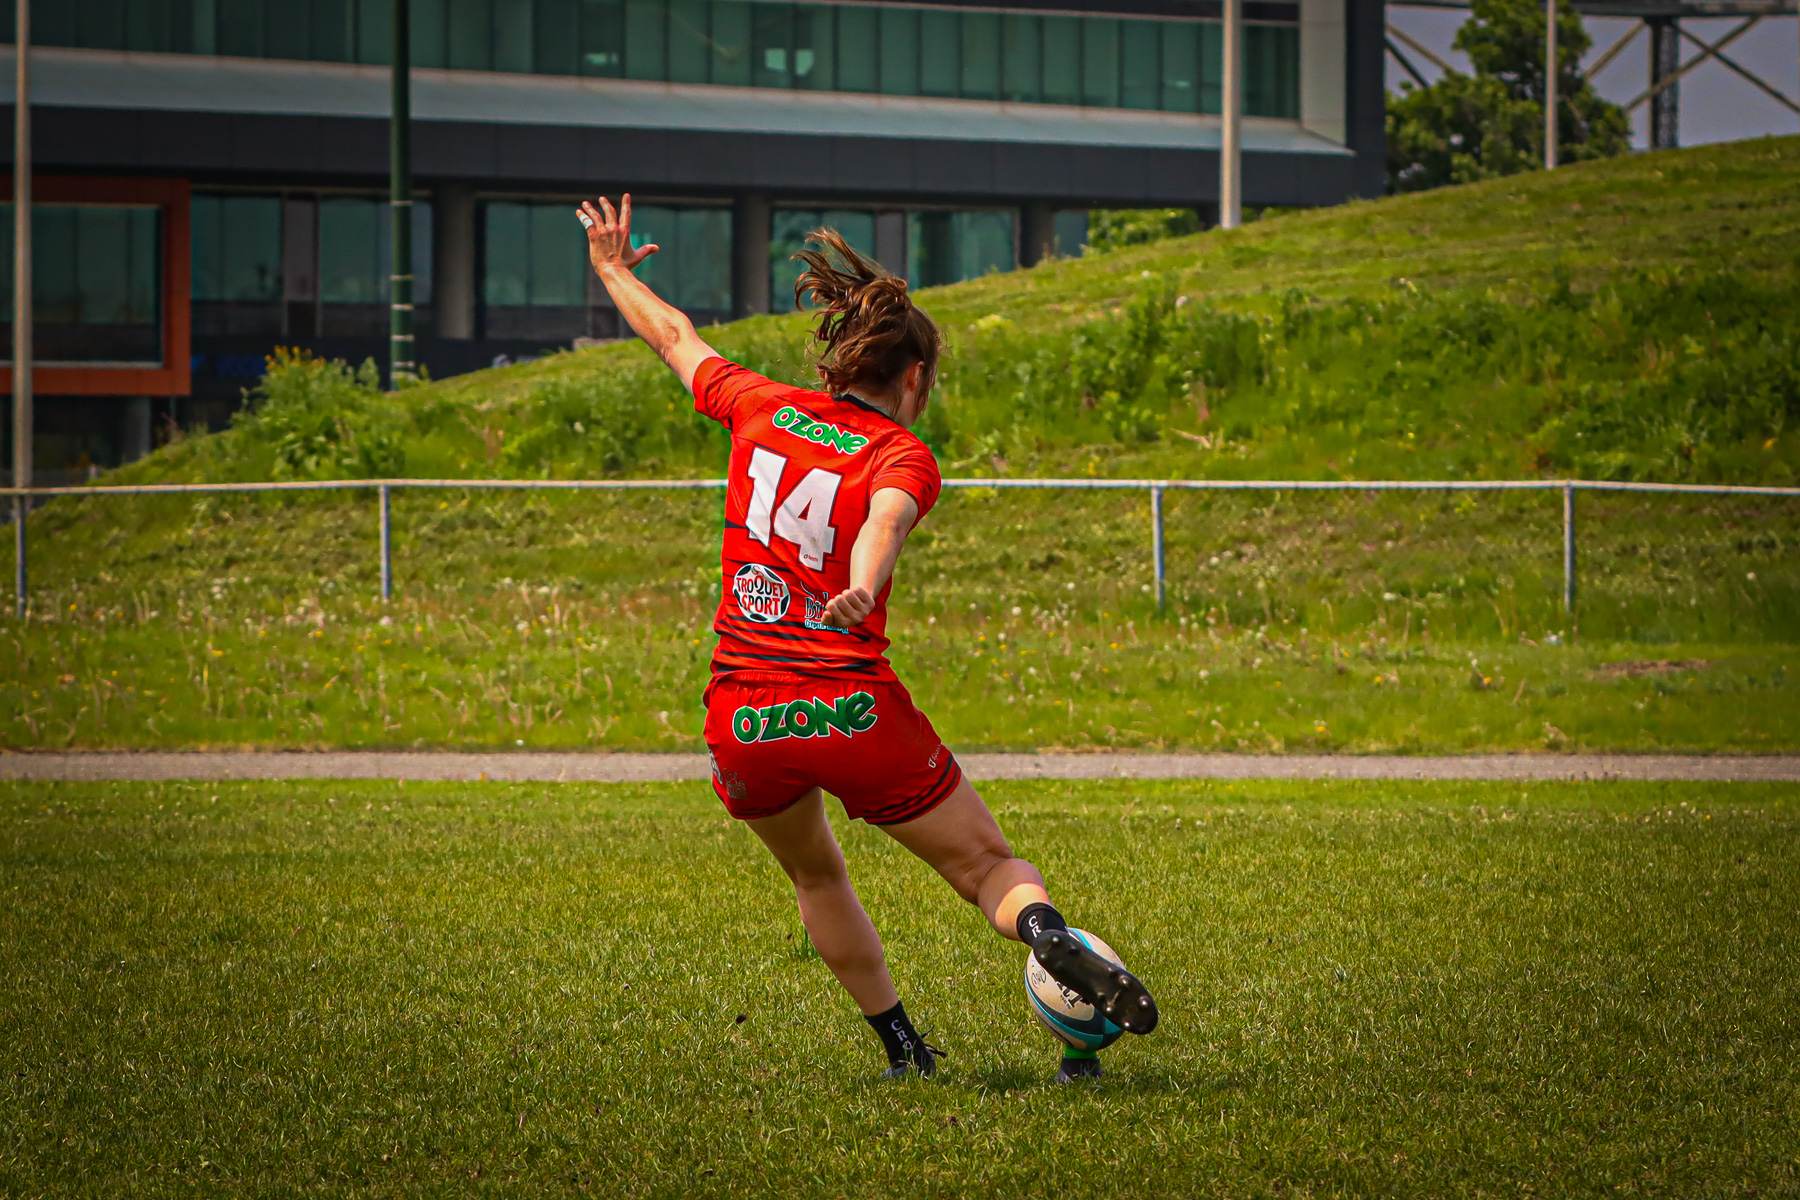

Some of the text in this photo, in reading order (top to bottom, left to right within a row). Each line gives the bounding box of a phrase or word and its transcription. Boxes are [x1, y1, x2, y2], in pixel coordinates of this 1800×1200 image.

[744, 446, 843, 573] 14
[736, 576, 784, 598] TROQUET
[741, 594, 780, 616] SPORT
[1028, 915, 1042, 938] CR
